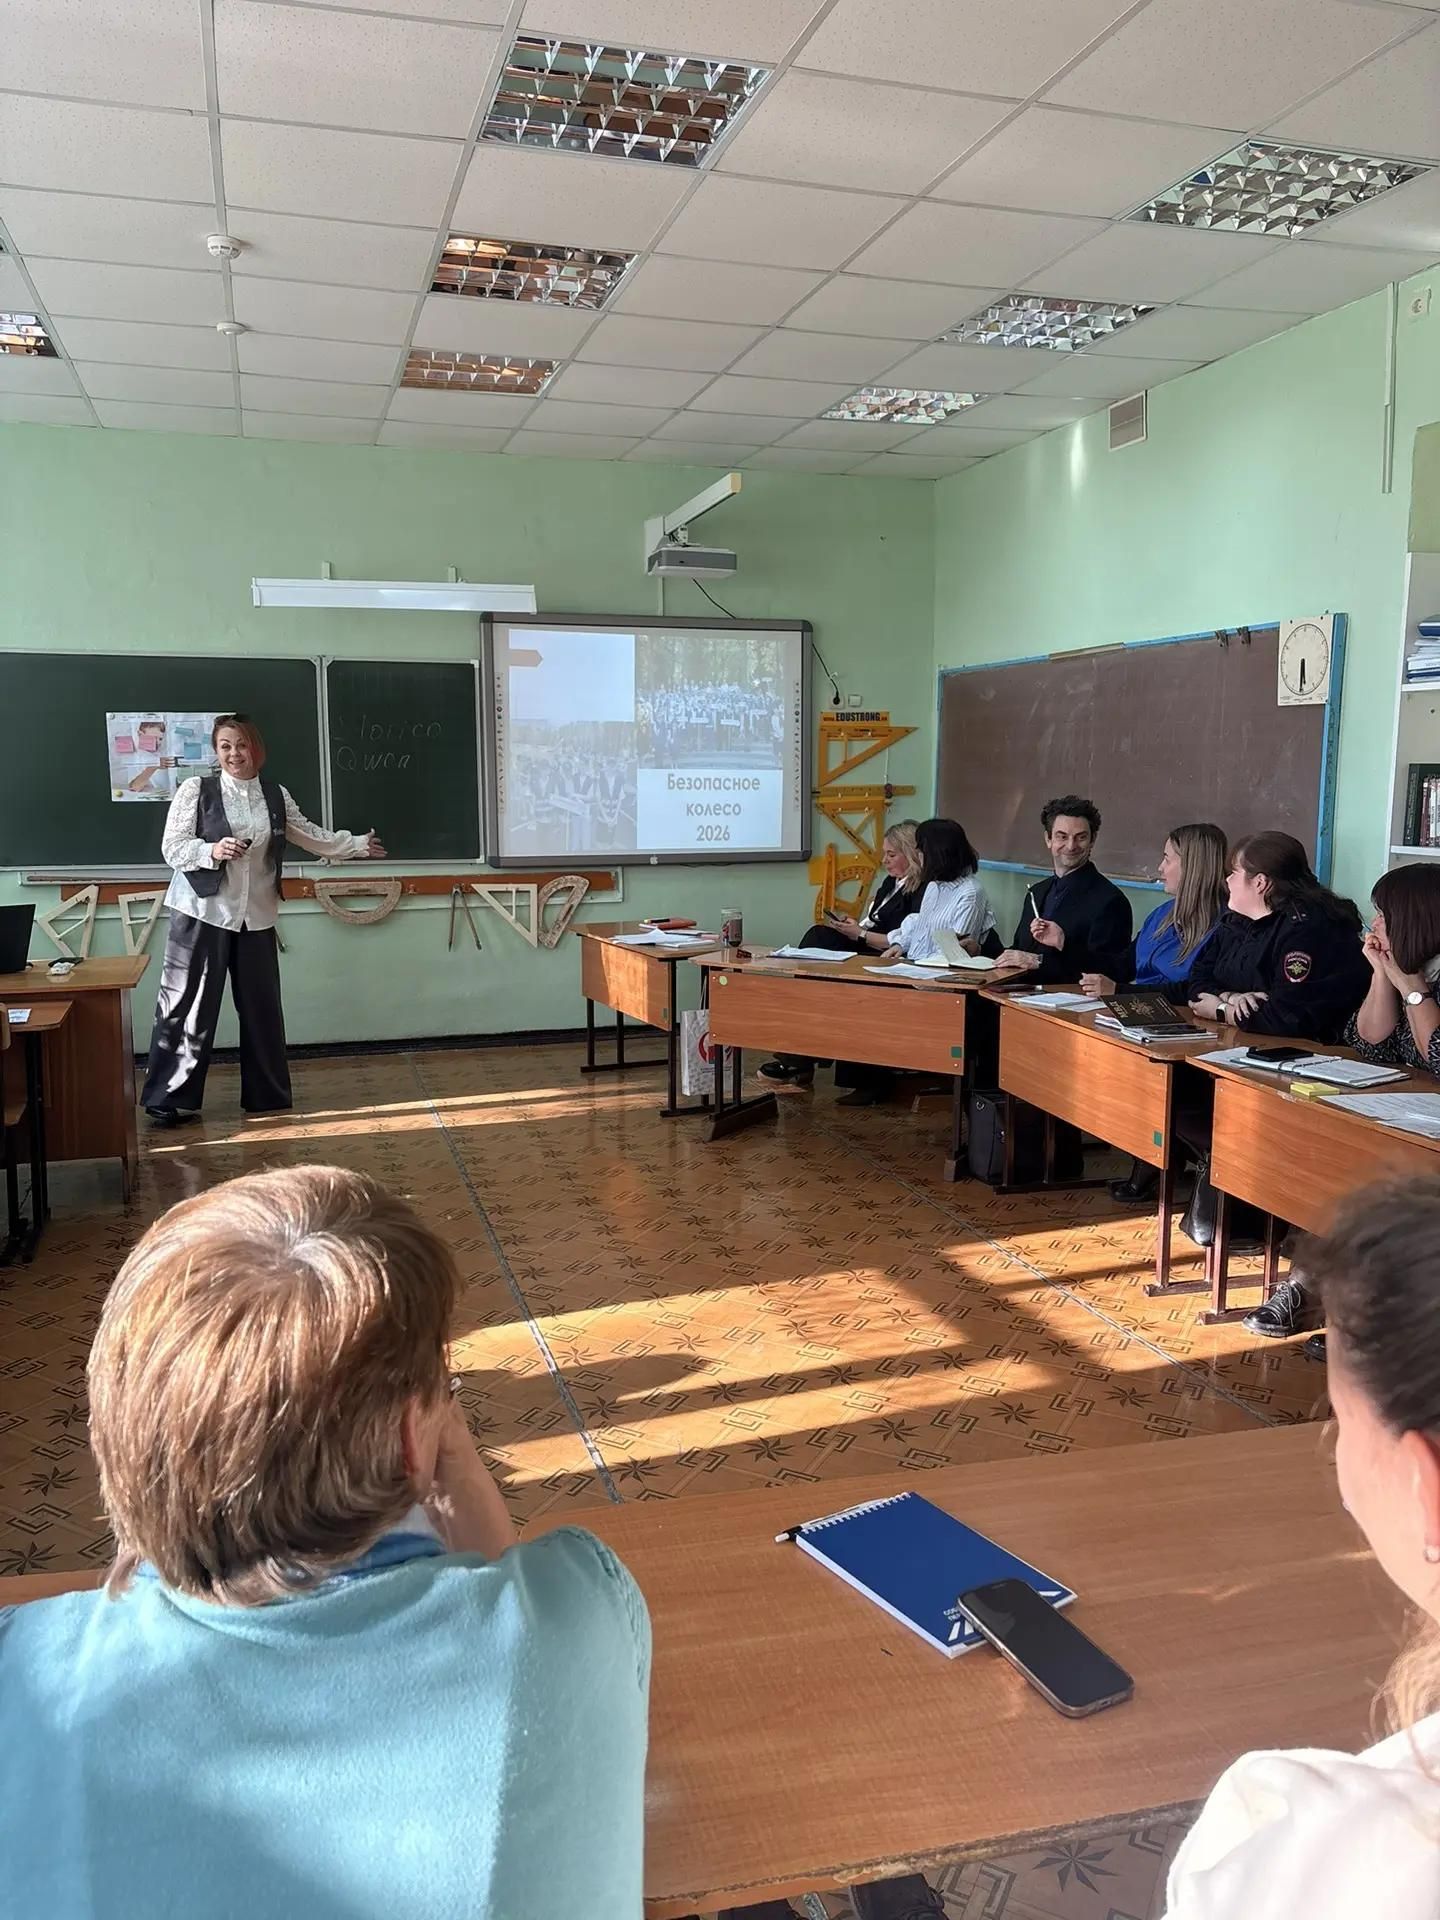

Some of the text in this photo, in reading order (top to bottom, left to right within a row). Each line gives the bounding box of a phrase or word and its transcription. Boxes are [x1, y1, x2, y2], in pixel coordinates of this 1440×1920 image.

[836, 712, 880, 721] EDUSTRONG
[667, 773, 760, 791] Безопасное
[686, 802, 742, 817] колесо
[696, 825, 731, 841] 2026
